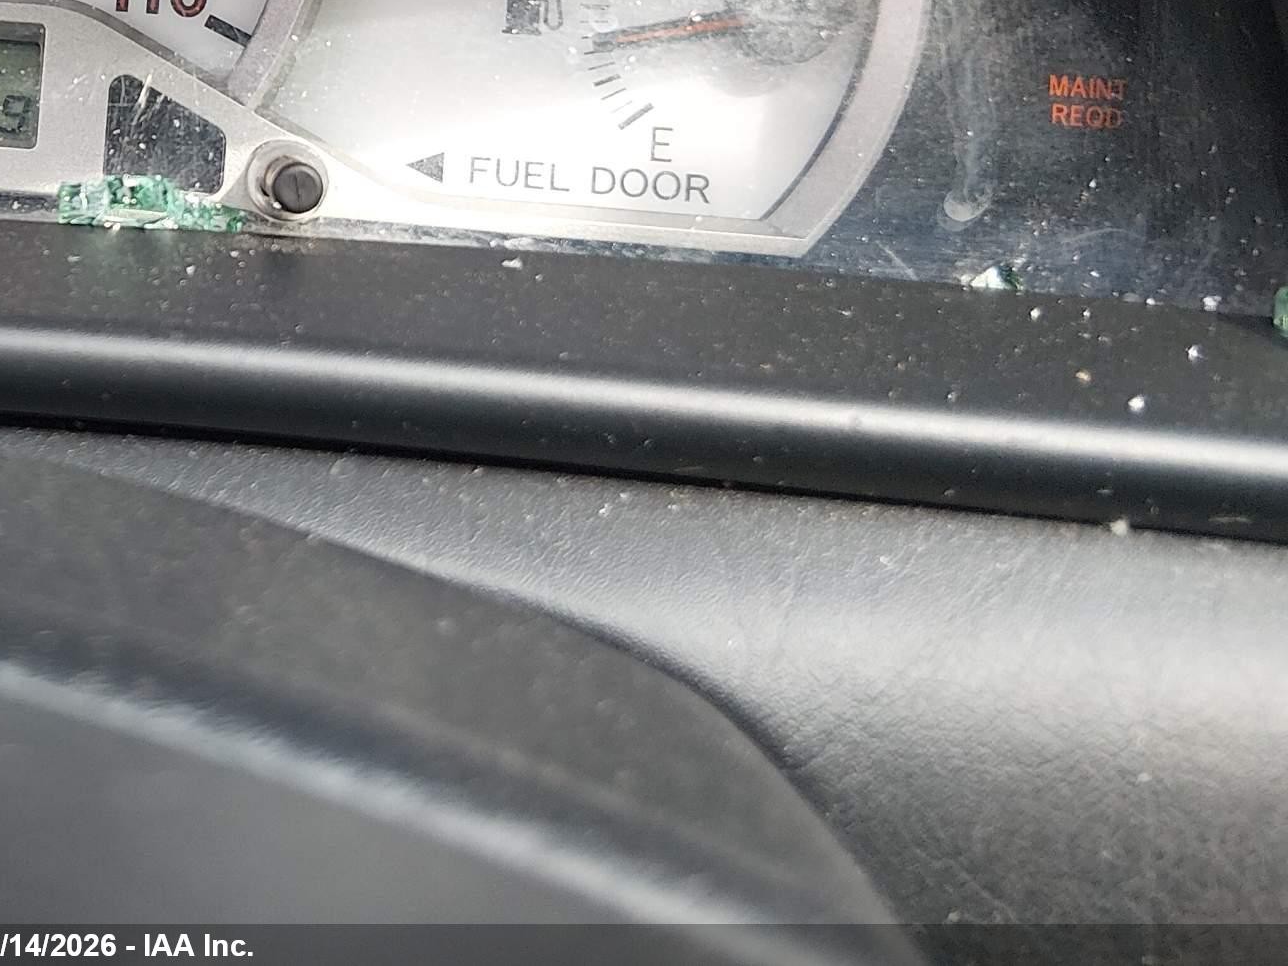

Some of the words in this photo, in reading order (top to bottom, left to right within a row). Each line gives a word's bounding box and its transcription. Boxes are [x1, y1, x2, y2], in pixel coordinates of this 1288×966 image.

[650, 126, 674, 162] E
[469, 156, 570, 192] FUEL
[591, 166, 710, 204] DOOR
